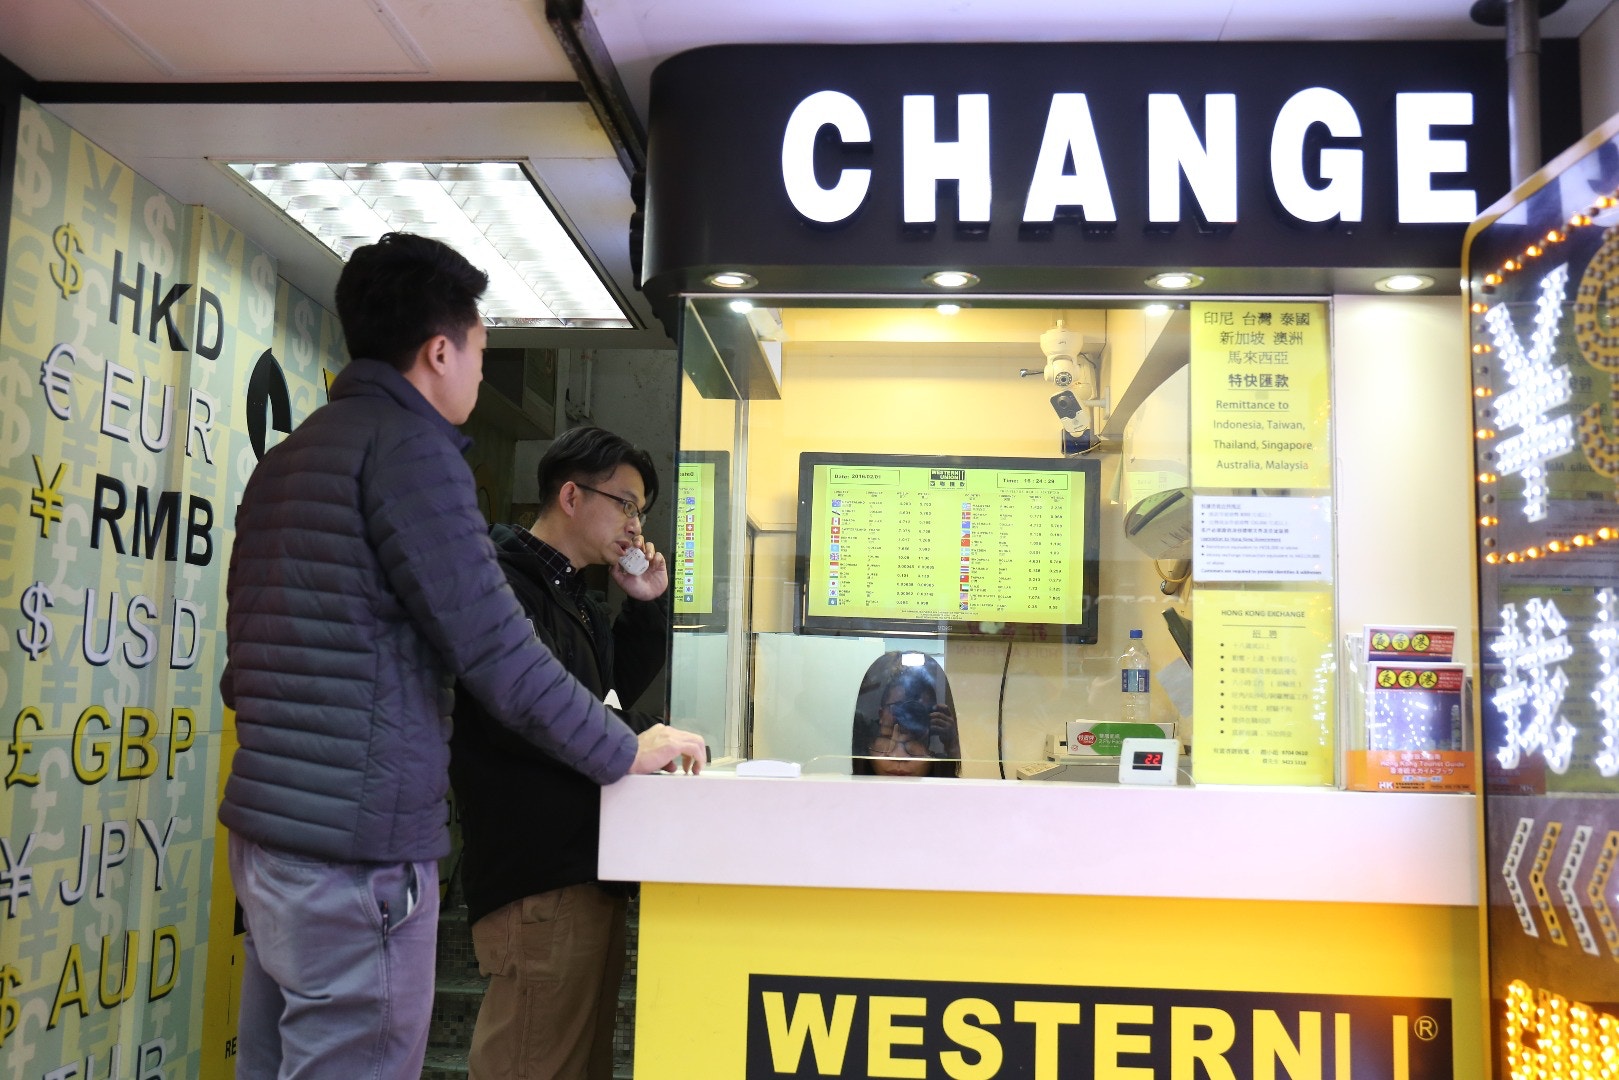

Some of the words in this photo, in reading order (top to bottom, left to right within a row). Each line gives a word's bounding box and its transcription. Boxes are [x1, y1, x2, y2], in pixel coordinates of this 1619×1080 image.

[781, 86, 1478, 225] CHANGE
[109, 249, 224, 361] HKD
[1204, 312, 1234, 325] 印尼
[1243, 312, 1272, 326] 台灣
[1281, 312, 1310, 326] 泰國
[1220, 331, 1265, 345] 新加坡
[1273, 331, 1303, 346] 澳洲
[1228, 351, 1289, 365] 馬來西亞
[1228, 374, 1289, 388] 特快匯款
[100, 360, 215, 465] EUR
[1213, 419, 1264, 430] Indonesia,
[1267, 420, 1306, 431] Taiwan,
[1216, 400, 1275, 410] Remittance
[1278, 401, 1289, 410] to
[1213, 440, 1259, 450] Thailand,
[1216, 460, 1263, 470] Australia,
[1266, 460, 1309, 472] Malaysia
[90, 473, 214, 567] RMB
[82, 588, 201, 670] USD
[71, 705, 196, 785] GBP
[1144, 754, 1161, 765] 22
[59, 816, 179, 906] JPY
[46, 925, 181, 1031] AUD
[761, 991, 1322, 1080] WESTERN
